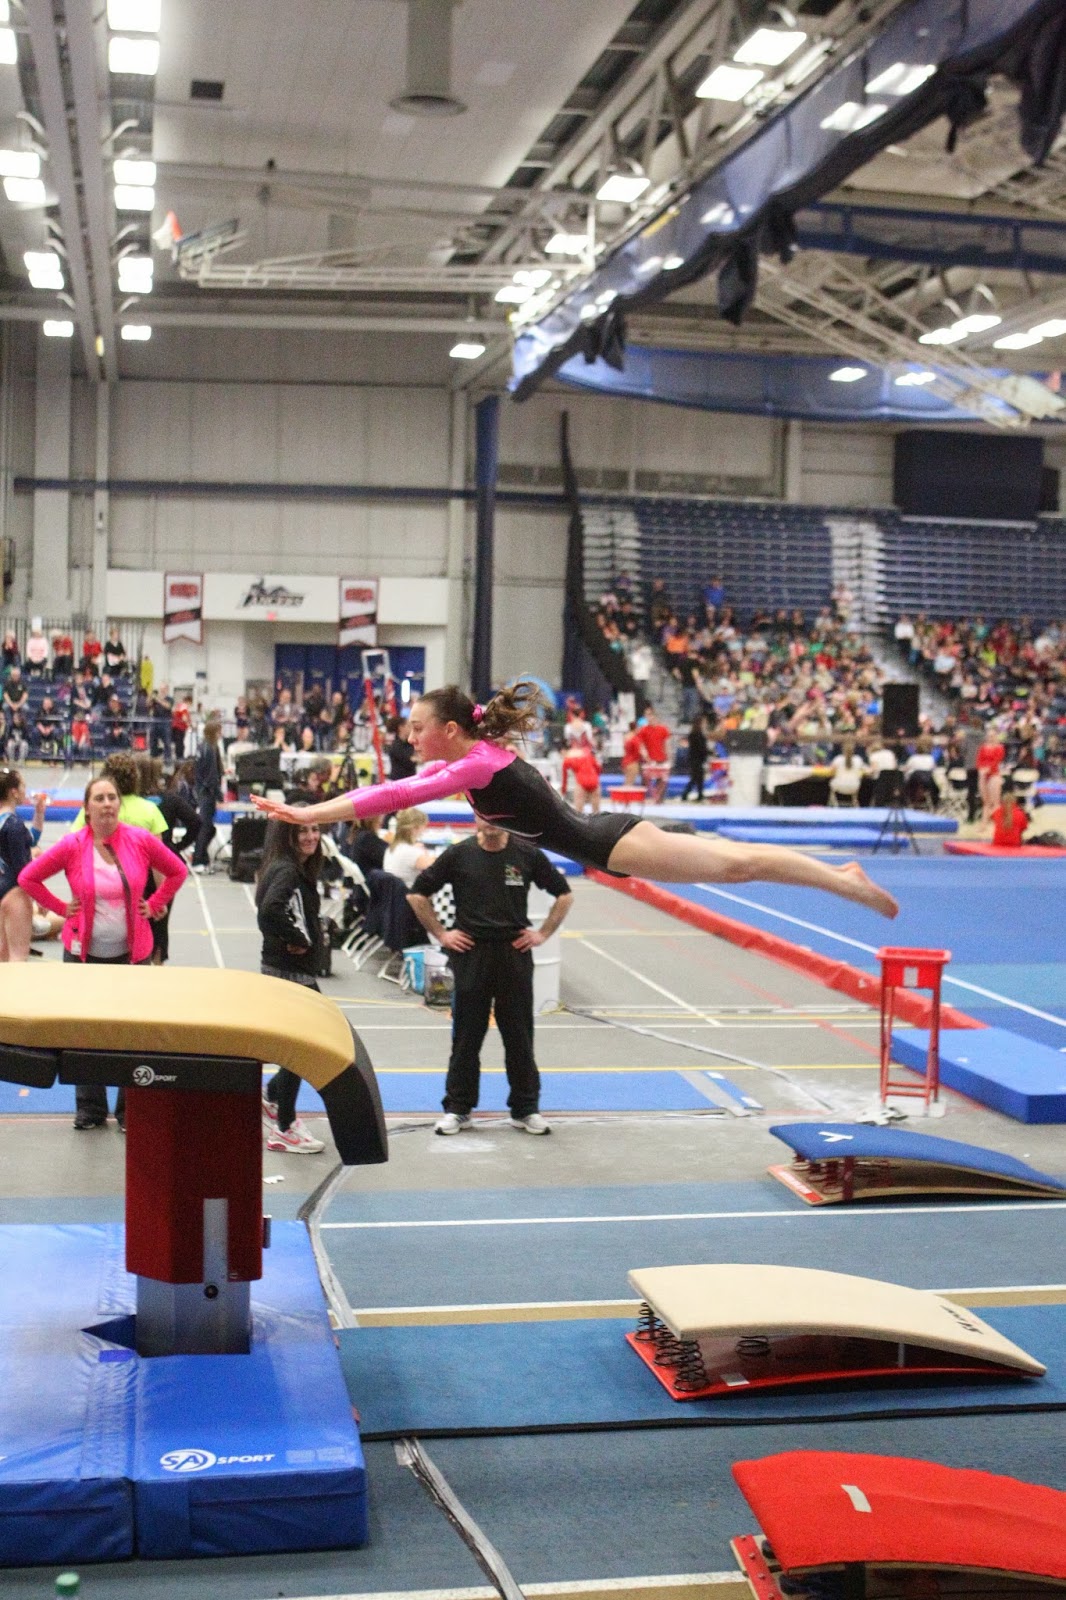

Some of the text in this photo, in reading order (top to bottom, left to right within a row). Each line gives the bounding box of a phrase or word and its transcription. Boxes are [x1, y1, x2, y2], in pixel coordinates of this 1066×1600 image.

[134, 1067, 177, 1084] SA SPORT
[161, 1451, 208, 1471] SA
[216, 1454, 276, 1465] SPORT
